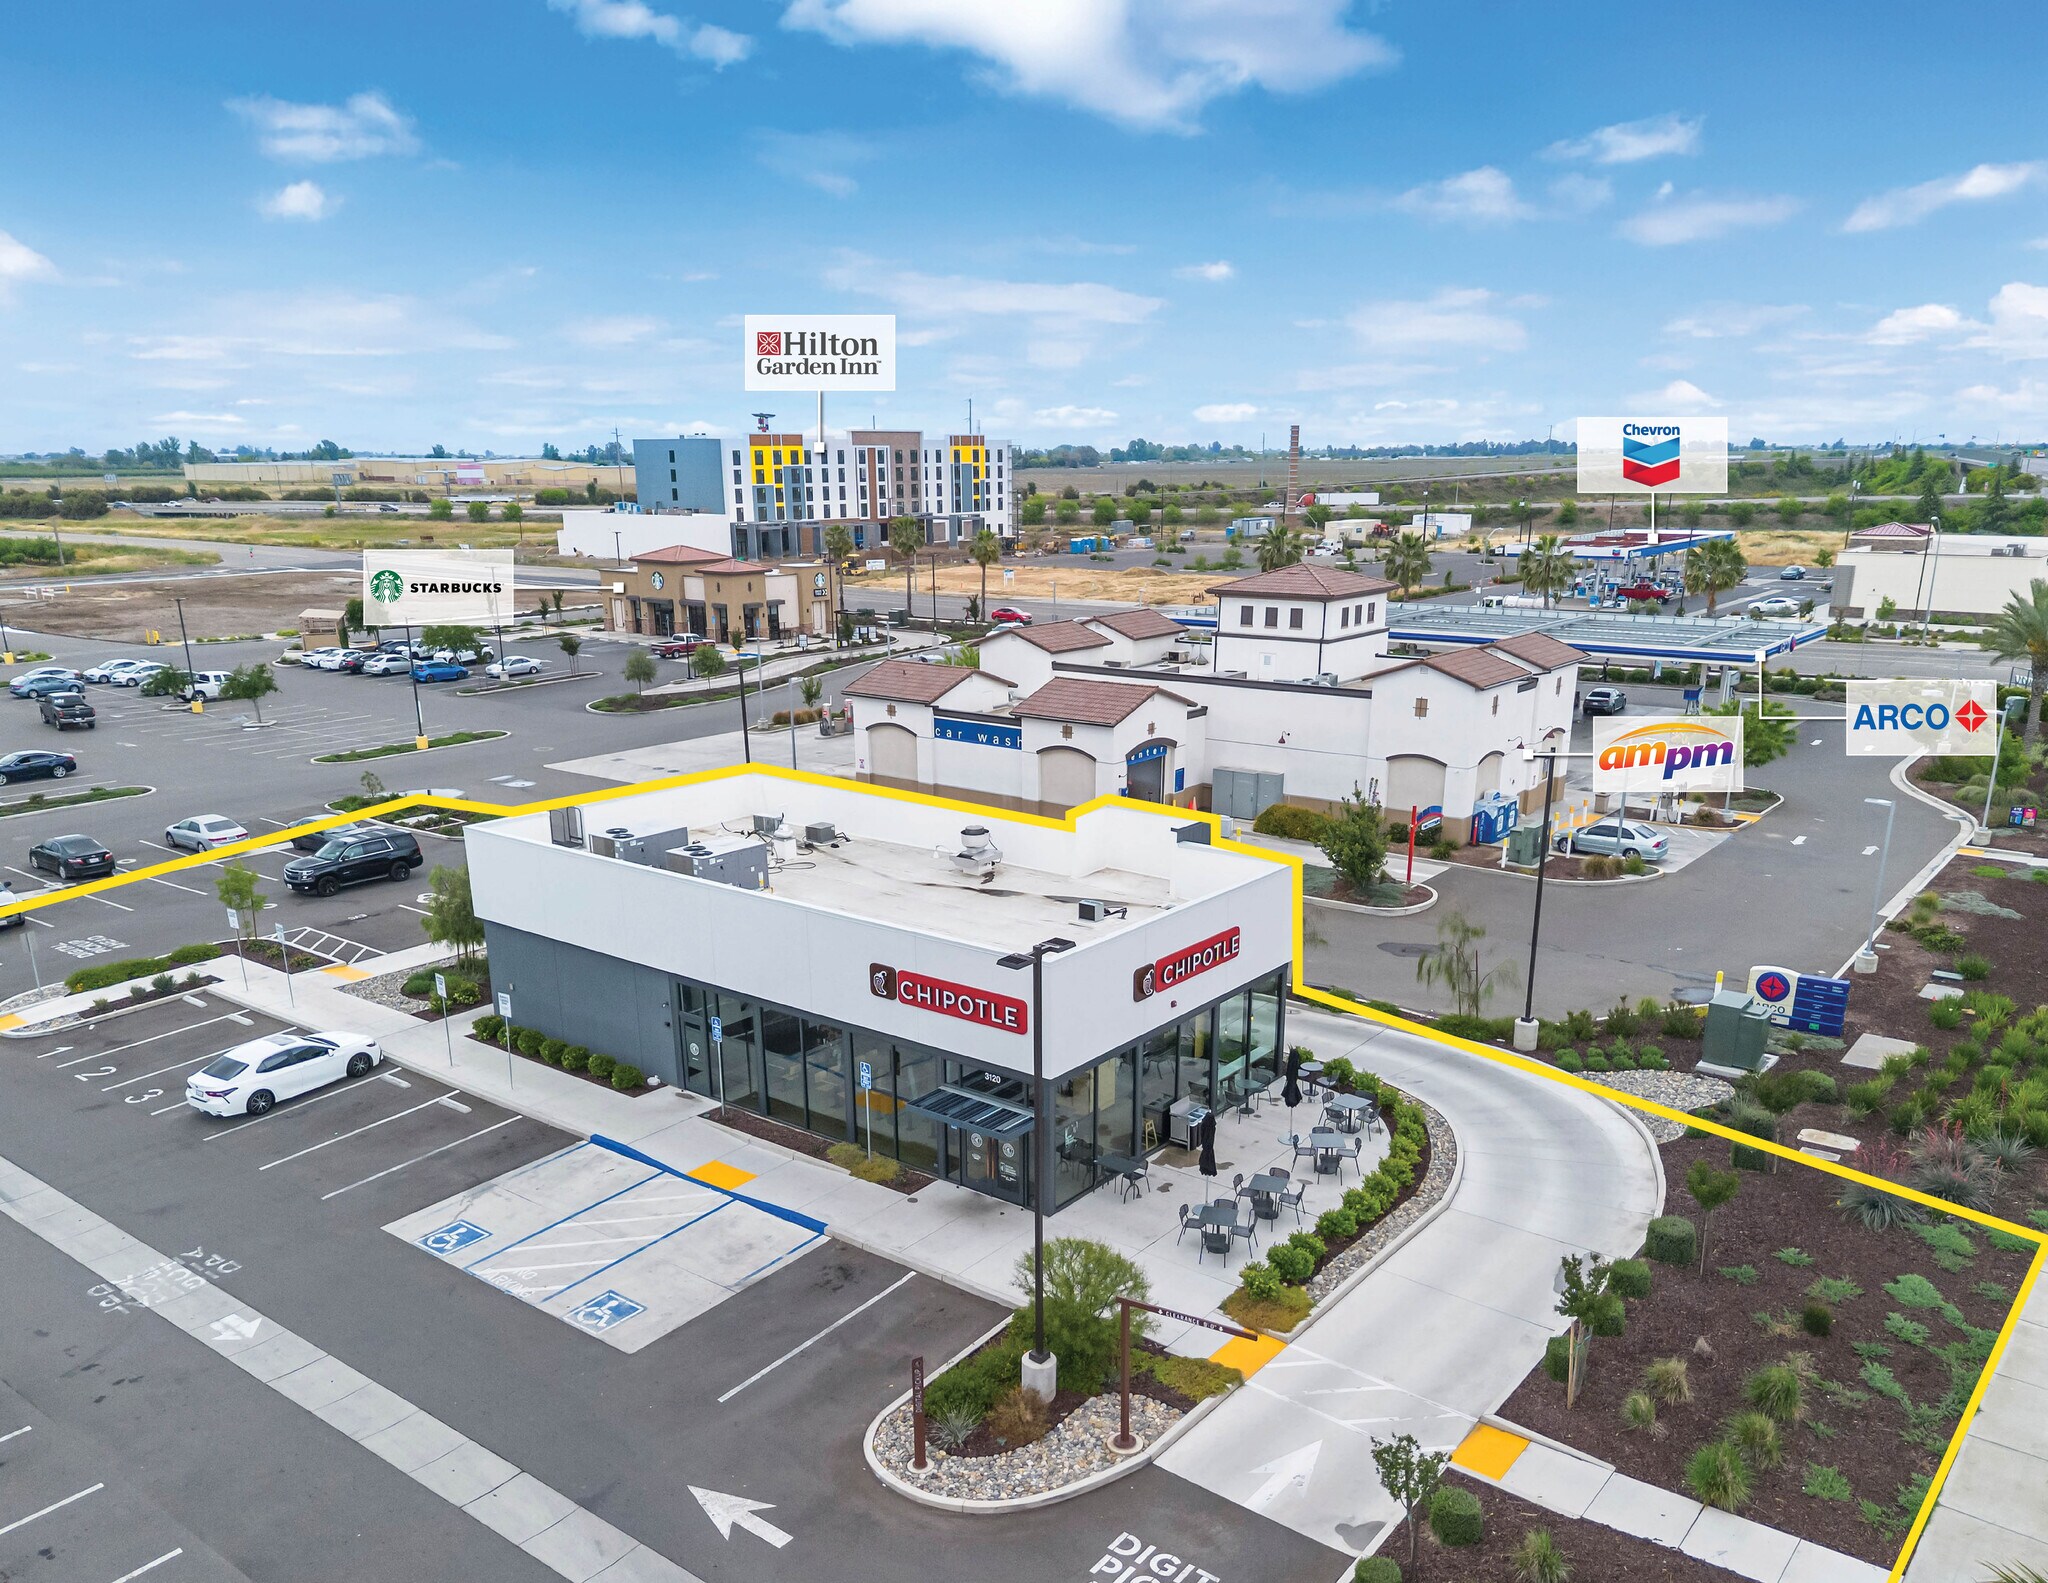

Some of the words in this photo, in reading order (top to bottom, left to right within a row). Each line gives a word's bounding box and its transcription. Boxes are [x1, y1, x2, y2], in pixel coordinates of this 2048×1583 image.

[935, 727, 963, 740] car
[977, 733, 1023, 748] wash
[1130, 746, 1165, 761] enter
[1163, 935, 1240, 985] CHIPOTLE
[900, 980, 1018, 1028] CHIPOTLE
[74, 1066, 117, 1082] 2
[984, 1072, 1002, 1084] 3120
[124, 1088, 164, 1104] 3
[1165, 1310, 1200, 1326] CLEARANCE
